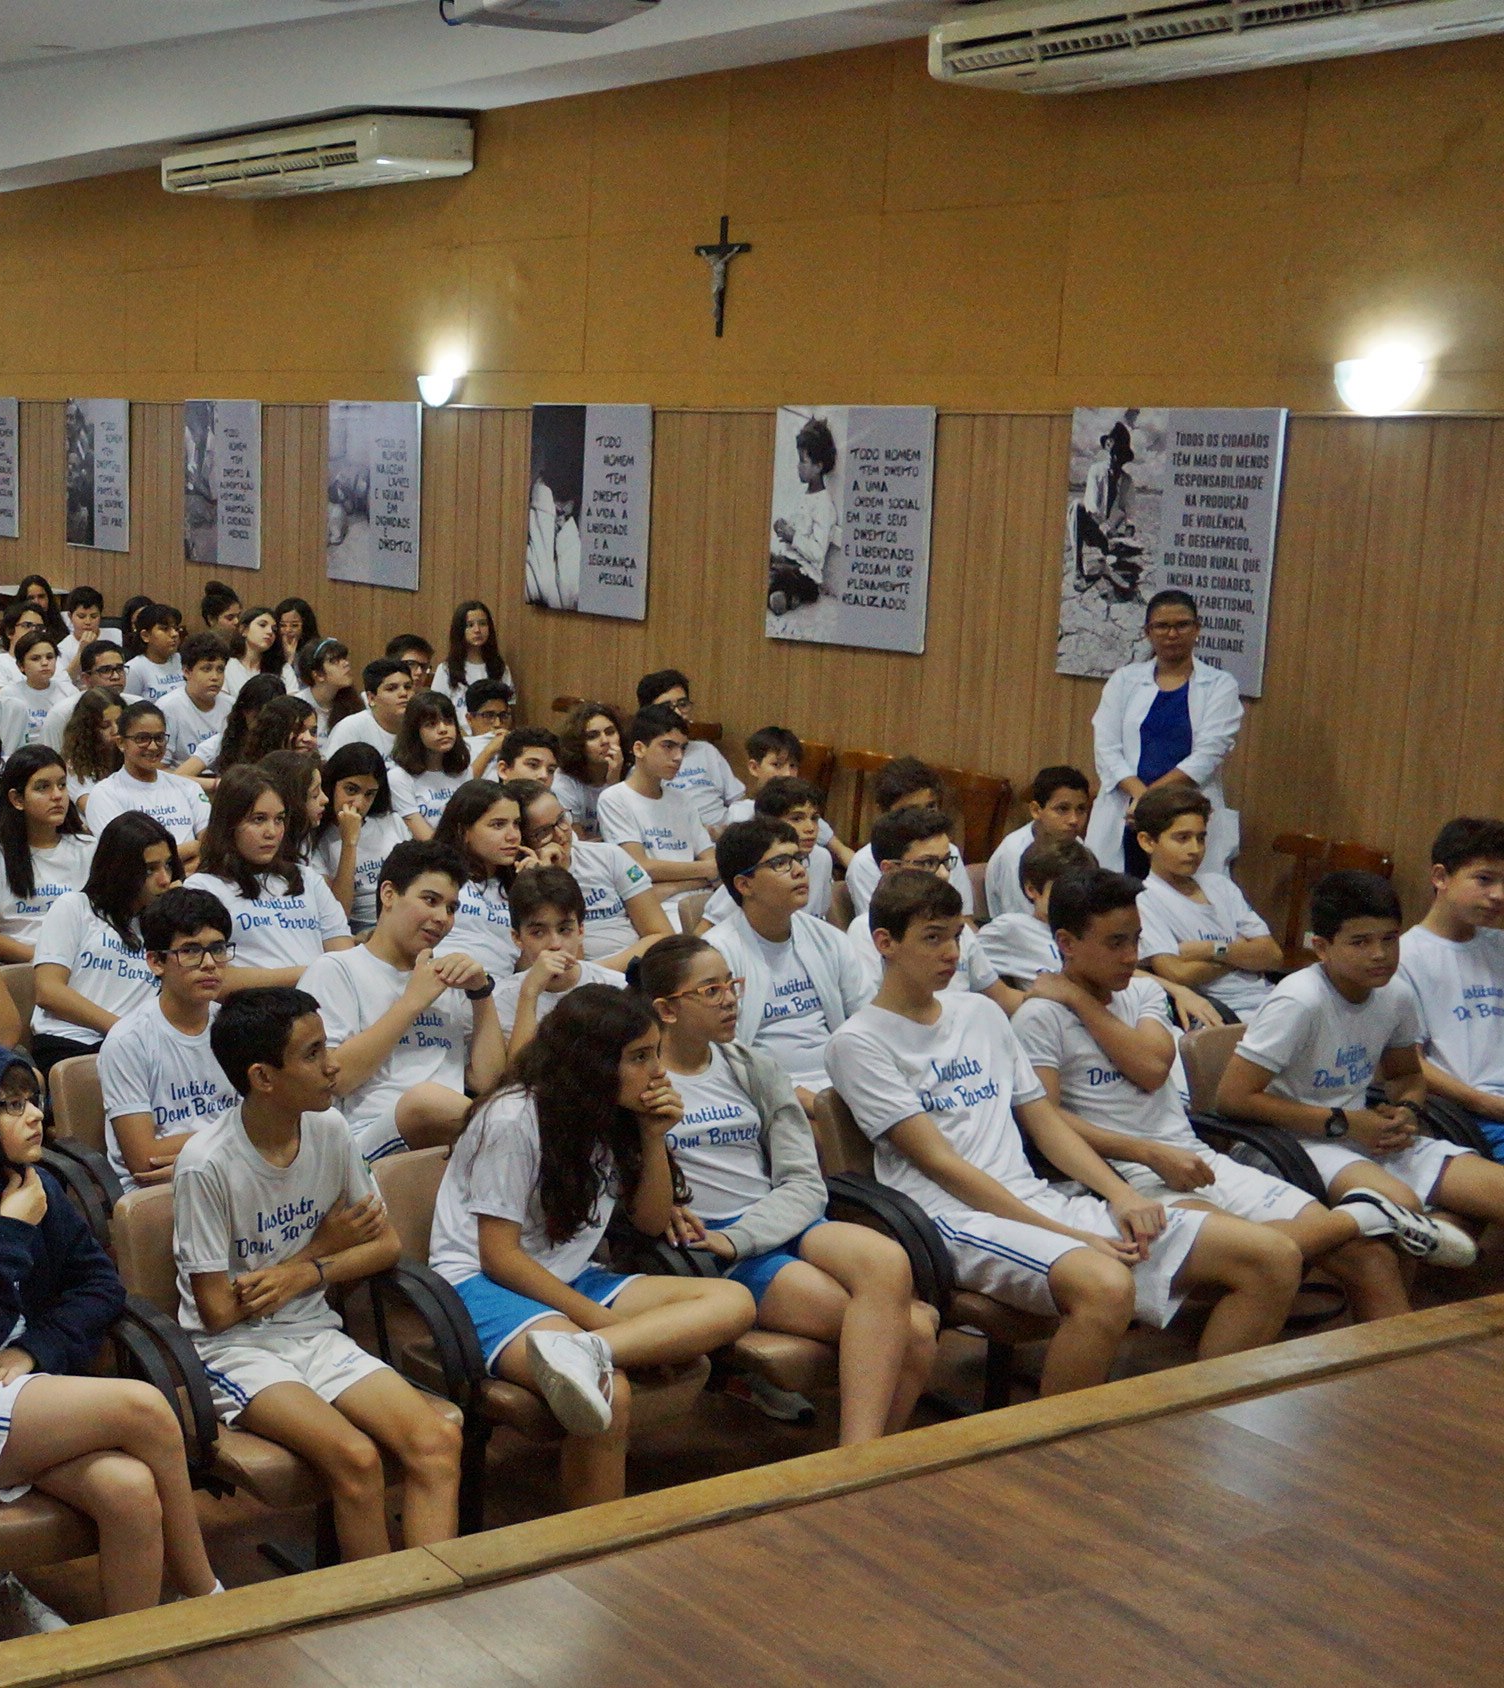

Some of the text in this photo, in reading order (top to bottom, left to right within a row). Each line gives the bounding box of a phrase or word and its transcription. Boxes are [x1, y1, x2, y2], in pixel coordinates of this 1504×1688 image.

[1175, 431, 1270, 449] TODOS OS CIDADÃOS
[850, 447, 921, 462] TODO HOMEM
[1172, 451, 1269, 469] TÊM MAIS OU MENOS
[859, 465, 880, 476] TEM
[852, 479, 889, 493] A UMA
[1174, 472, 1264, 490] RESPONSABILIDADE
[854, 495, 920, 511] ORDEM SOCIAL
[1184, 493, 1249, 510] NA PRODUÇÃO
[846, 511, 860, 523] EM
[887, 513, 907, 527] SEUS
[1182, 513, 1247, 532] DE VIOLÊNCIA,
[853, 528, 898, 543] DIREITOS
[1174, 533, 1253, 553] DE DESEMPREGO,
[855, 544, 915, 562] LIBERDADES
[1163, 551, 1261, 573] DO ÊXODO RURAL QUE
[851, 561, 913, 578] POSSAM SER
[846, 577, 911, 594] PLENAMENTE
[1166, 571, 1254, 594] INCHA AS CIDADES,
[842, 592, 907, 611] REALIZADOS
[235, 912, 273, 932] Dom
[80, 950, 114, 971] Dom
[763, 1001, 792, 1020] Dom
[920, 1090, 958, 1113] Dom
[153, 1104, 190, 1125] Dom
[235, 1237, 274, 1259] Dom
